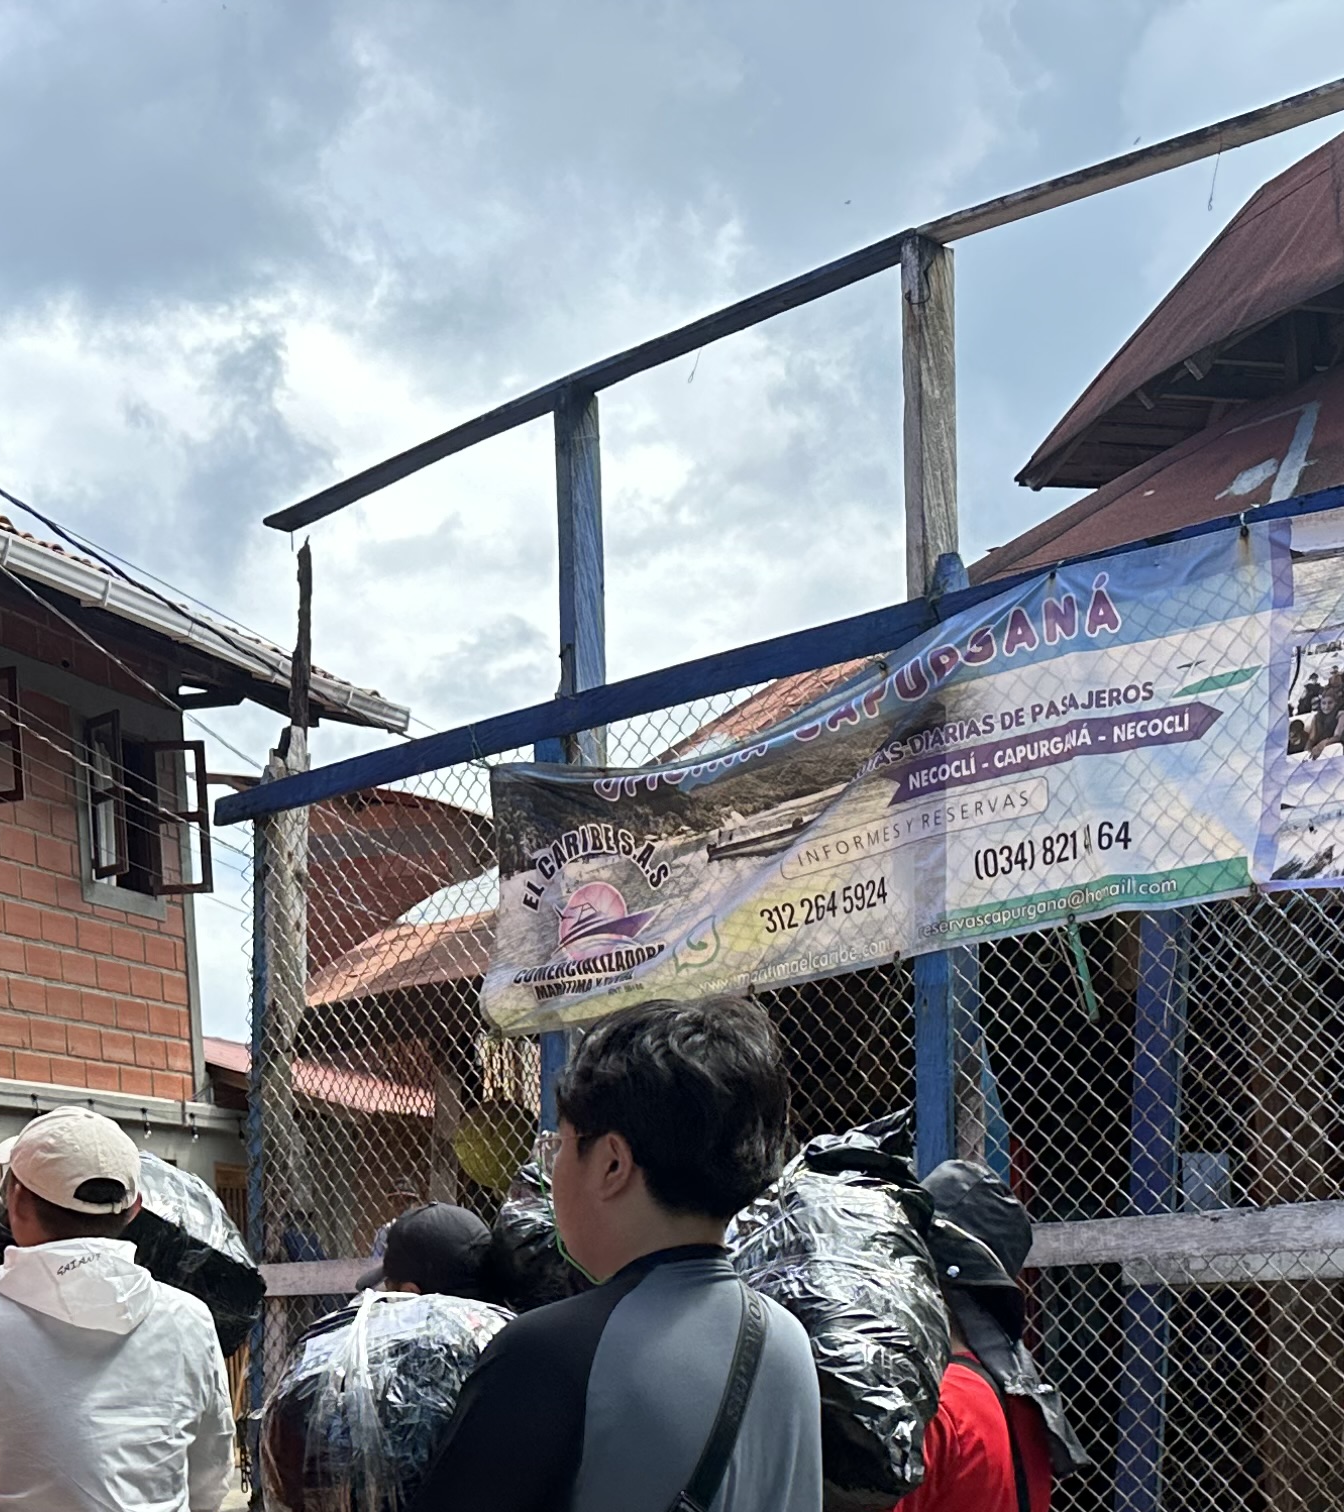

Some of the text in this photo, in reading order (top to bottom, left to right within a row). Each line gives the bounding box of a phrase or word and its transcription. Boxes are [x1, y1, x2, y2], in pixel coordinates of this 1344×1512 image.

[793, 571, 1122, 742] APURGANÁ
[906, 682, 1155, 756] DIARIAS DE PASAJEROS
[908, 753, 977, 791] NECOCLÍ
[993, 724, 1092, 769] CAPURGANÁ
[1112, 709, 1190, 743] NECOCLÍ
[797, 790, 1030, 867] INFORMES Y RESERVAS
[974, 840, 1035, 880] (034)
[1043, 830, 1078, 865] 821
[523, 881, 545, 911] EL
[537, 824, 618, 880] CARIBE
[760, 877, 888, 933] 312 264 5924
